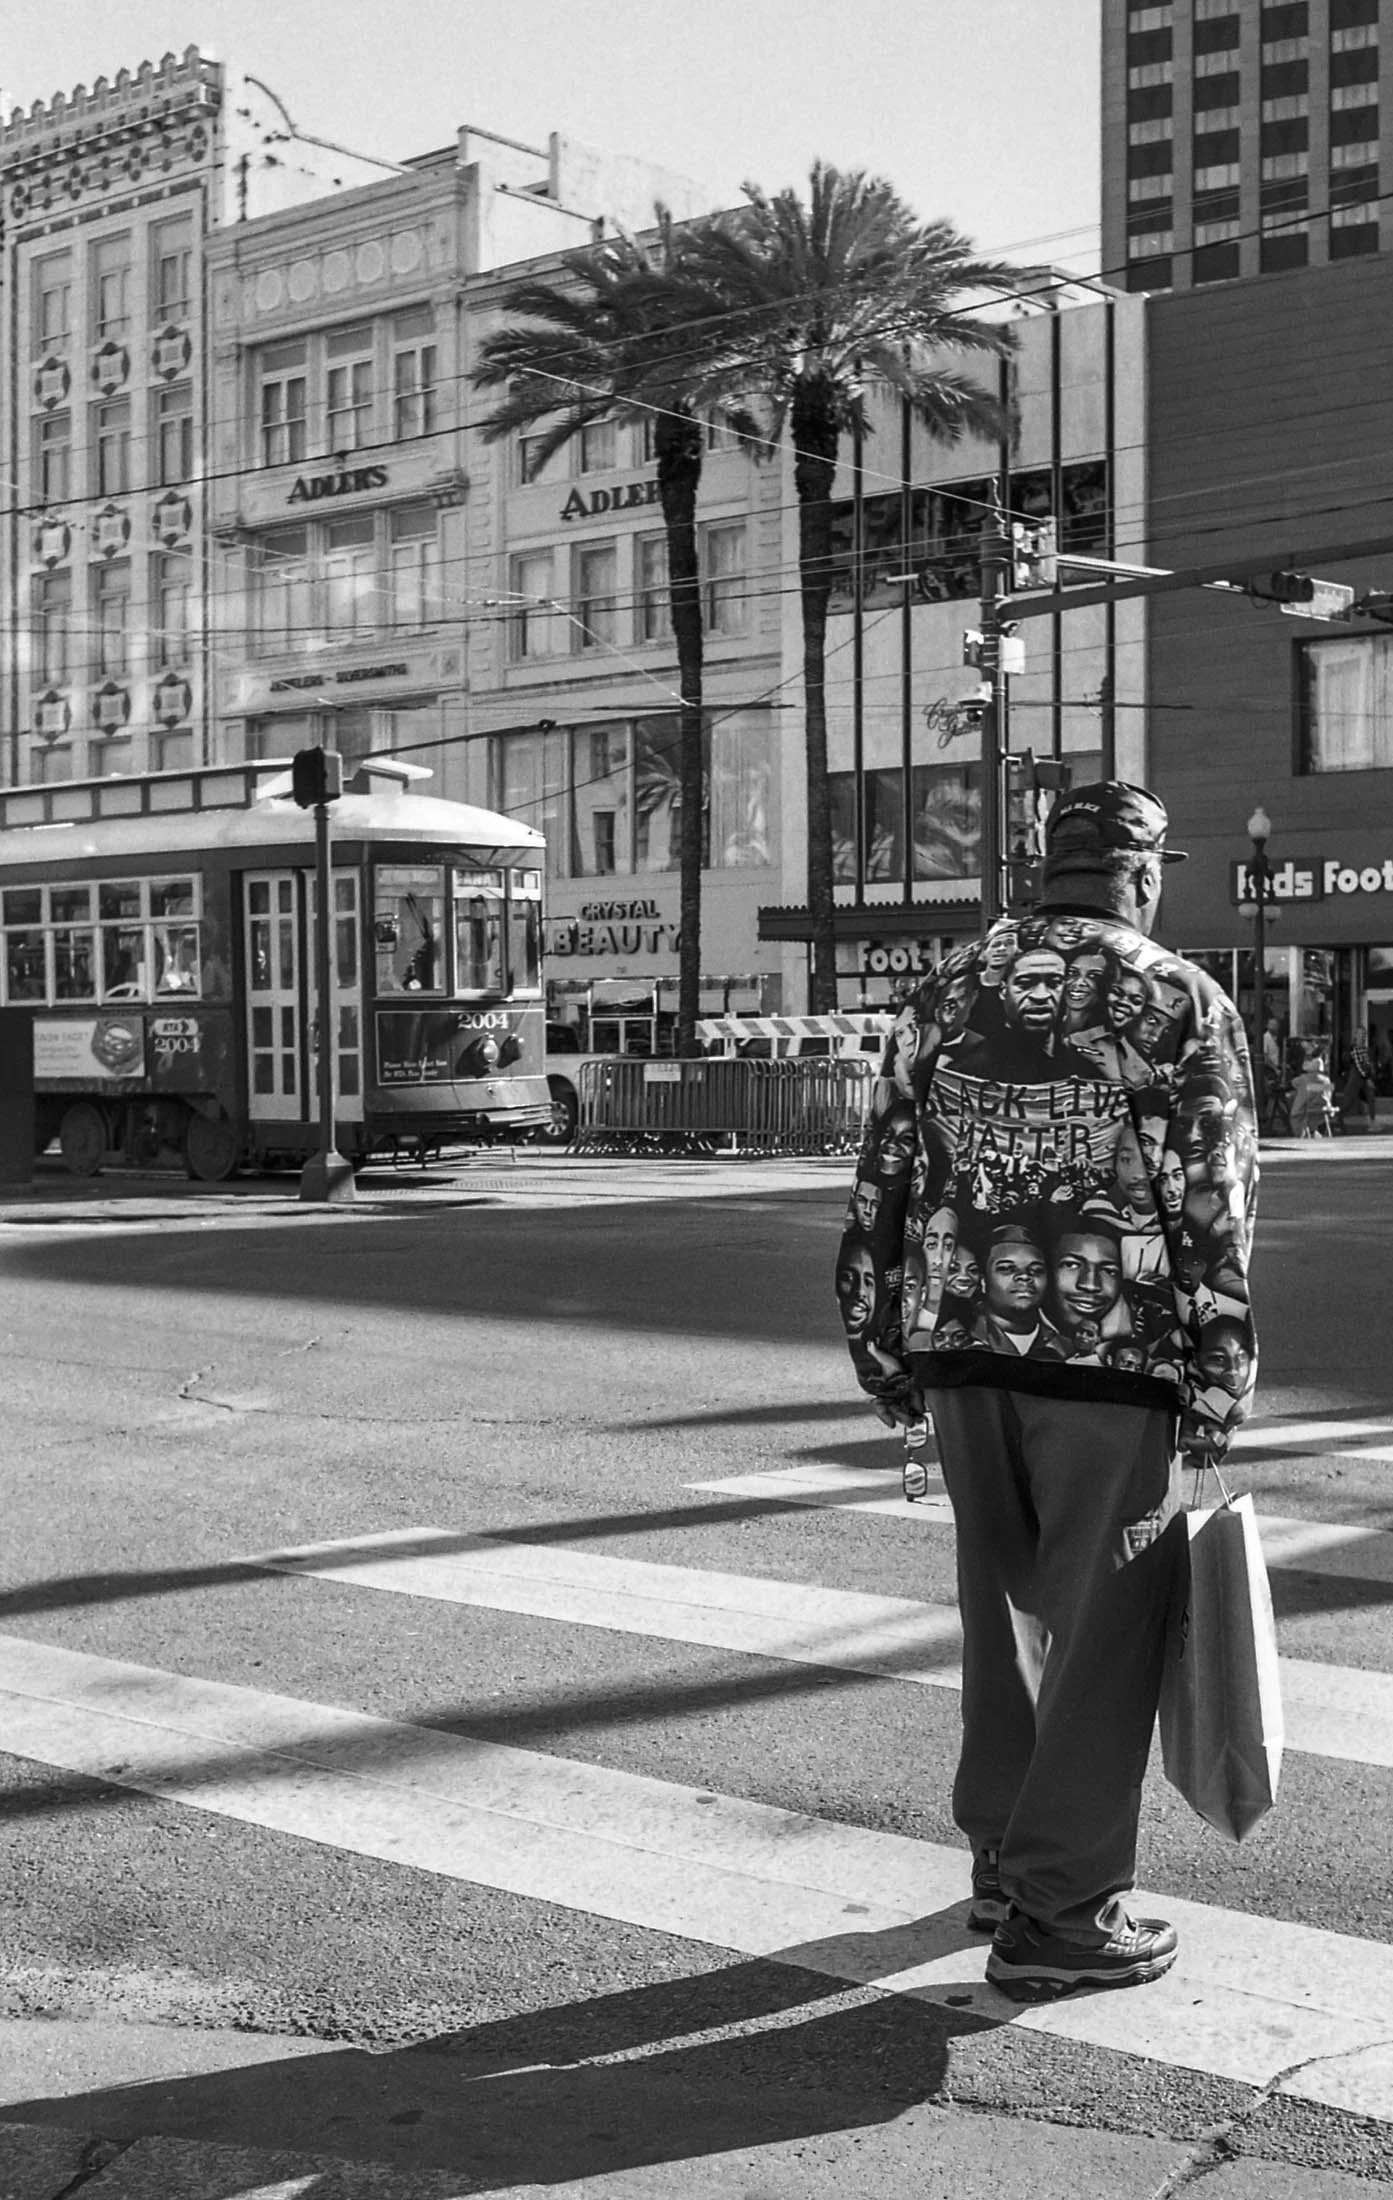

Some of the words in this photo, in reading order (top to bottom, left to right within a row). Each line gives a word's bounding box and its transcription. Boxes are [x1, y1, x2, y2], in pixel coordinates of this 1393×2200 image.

[1324, 860, 1393, 893] Foot
[580, 899, 661, 921] CRYSTAL
[553, 924, 682, 956] BEAUTY
[858, 940, 922, 973] Foot
[457, 1012, 509, 1029] 2004
[154, 1038, 201, 1053] 2004
[924, 1080, 1028, 1119] BLACK
[957, 1118, 1093, 1163] MATTER
